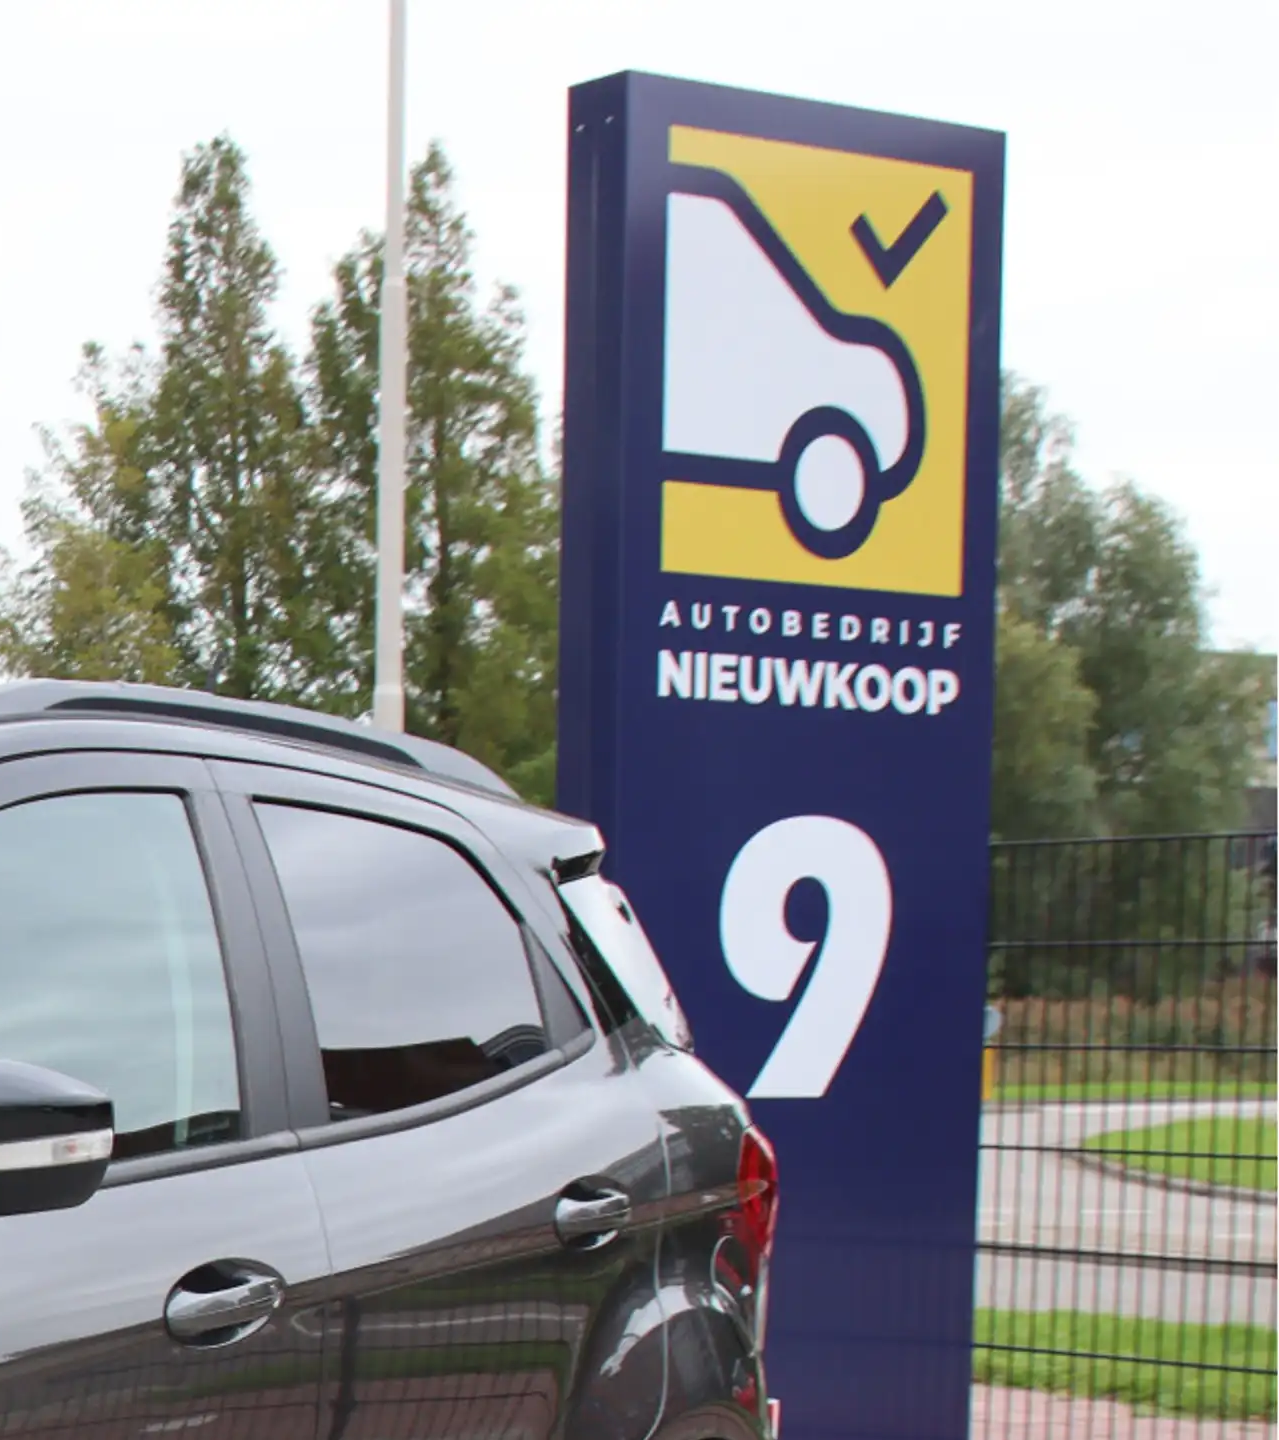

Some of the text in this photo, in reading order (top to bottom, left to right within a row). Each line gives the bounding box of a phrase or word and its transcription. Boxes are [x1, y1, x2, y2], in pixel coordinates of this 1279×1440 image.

[658, 600, 962, 649] AUTOBEDRIJF
[656, 649, 961, 715] NIEUWKOOP
[719, 814, 893, 1098] 9
